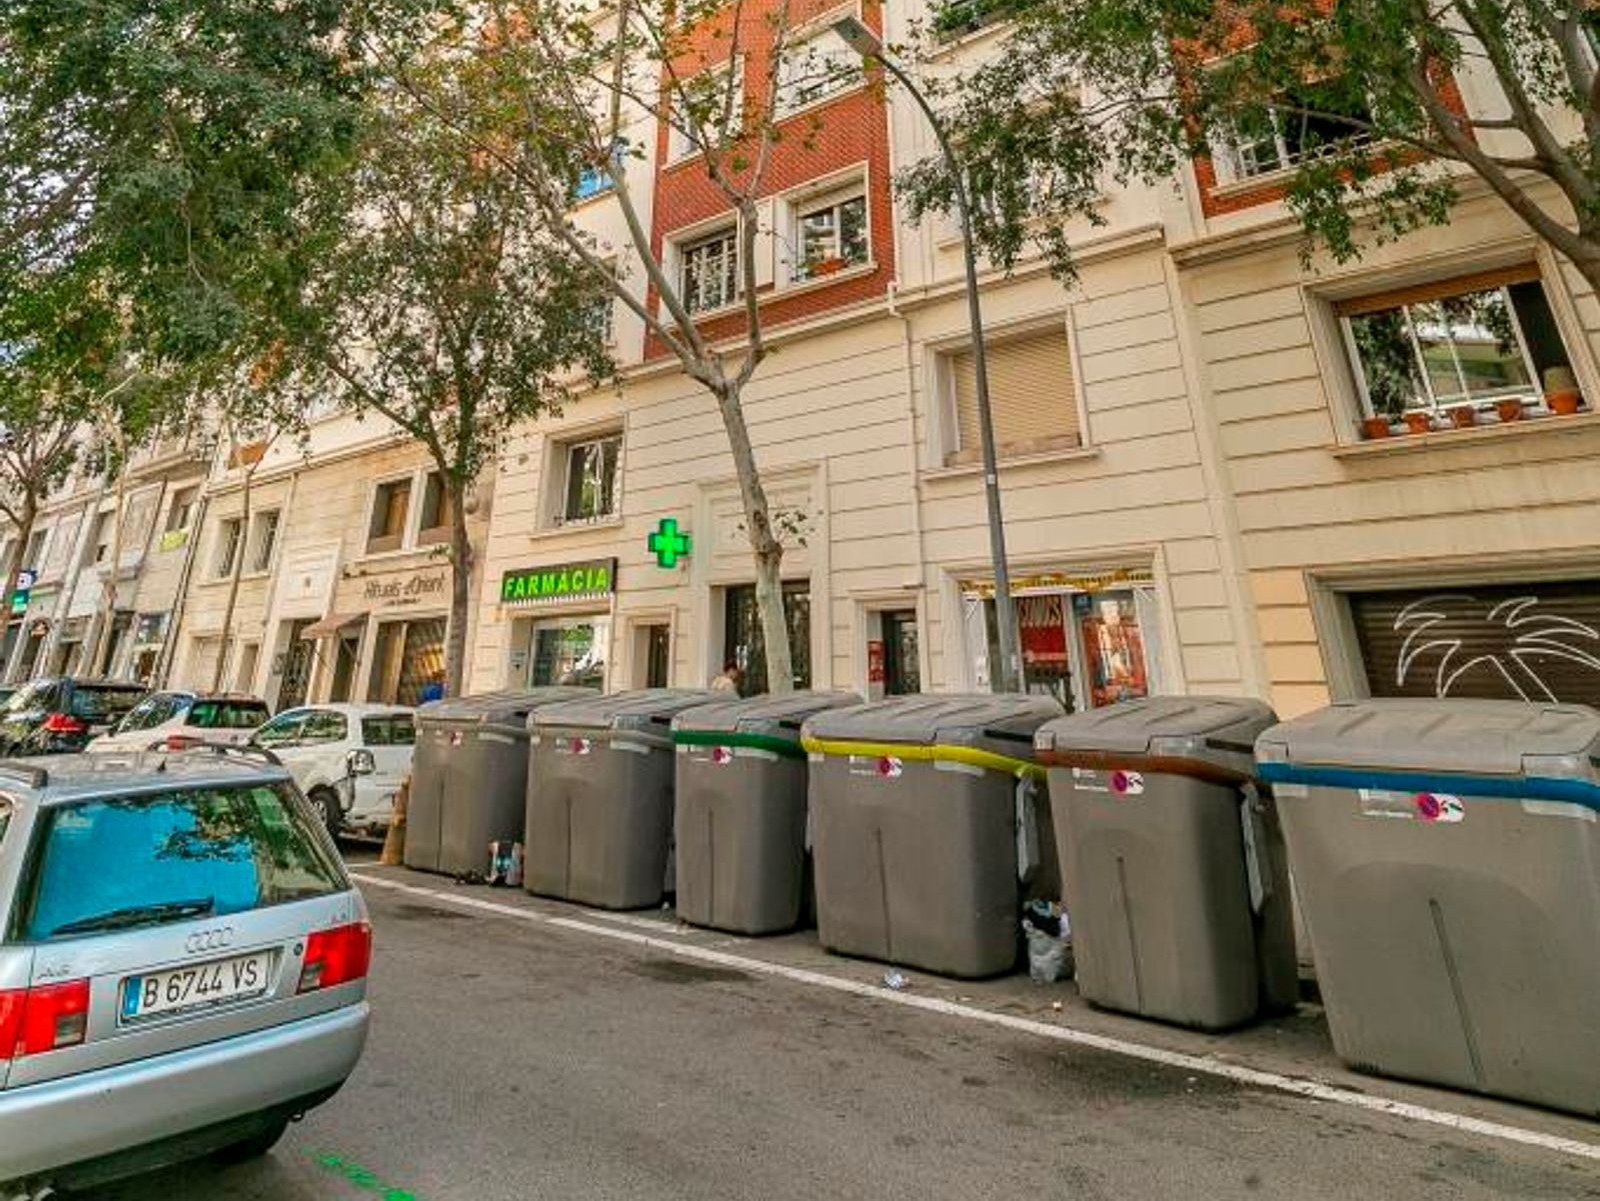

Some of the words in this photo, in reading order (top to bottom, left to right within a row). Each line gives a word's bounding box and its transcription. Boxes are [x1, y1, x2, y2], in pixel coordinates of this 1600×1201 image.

[144, 978, 159, 1008] B
[166, 965, 223, 1003] 6744
[232, 959, 258, 990] VS
